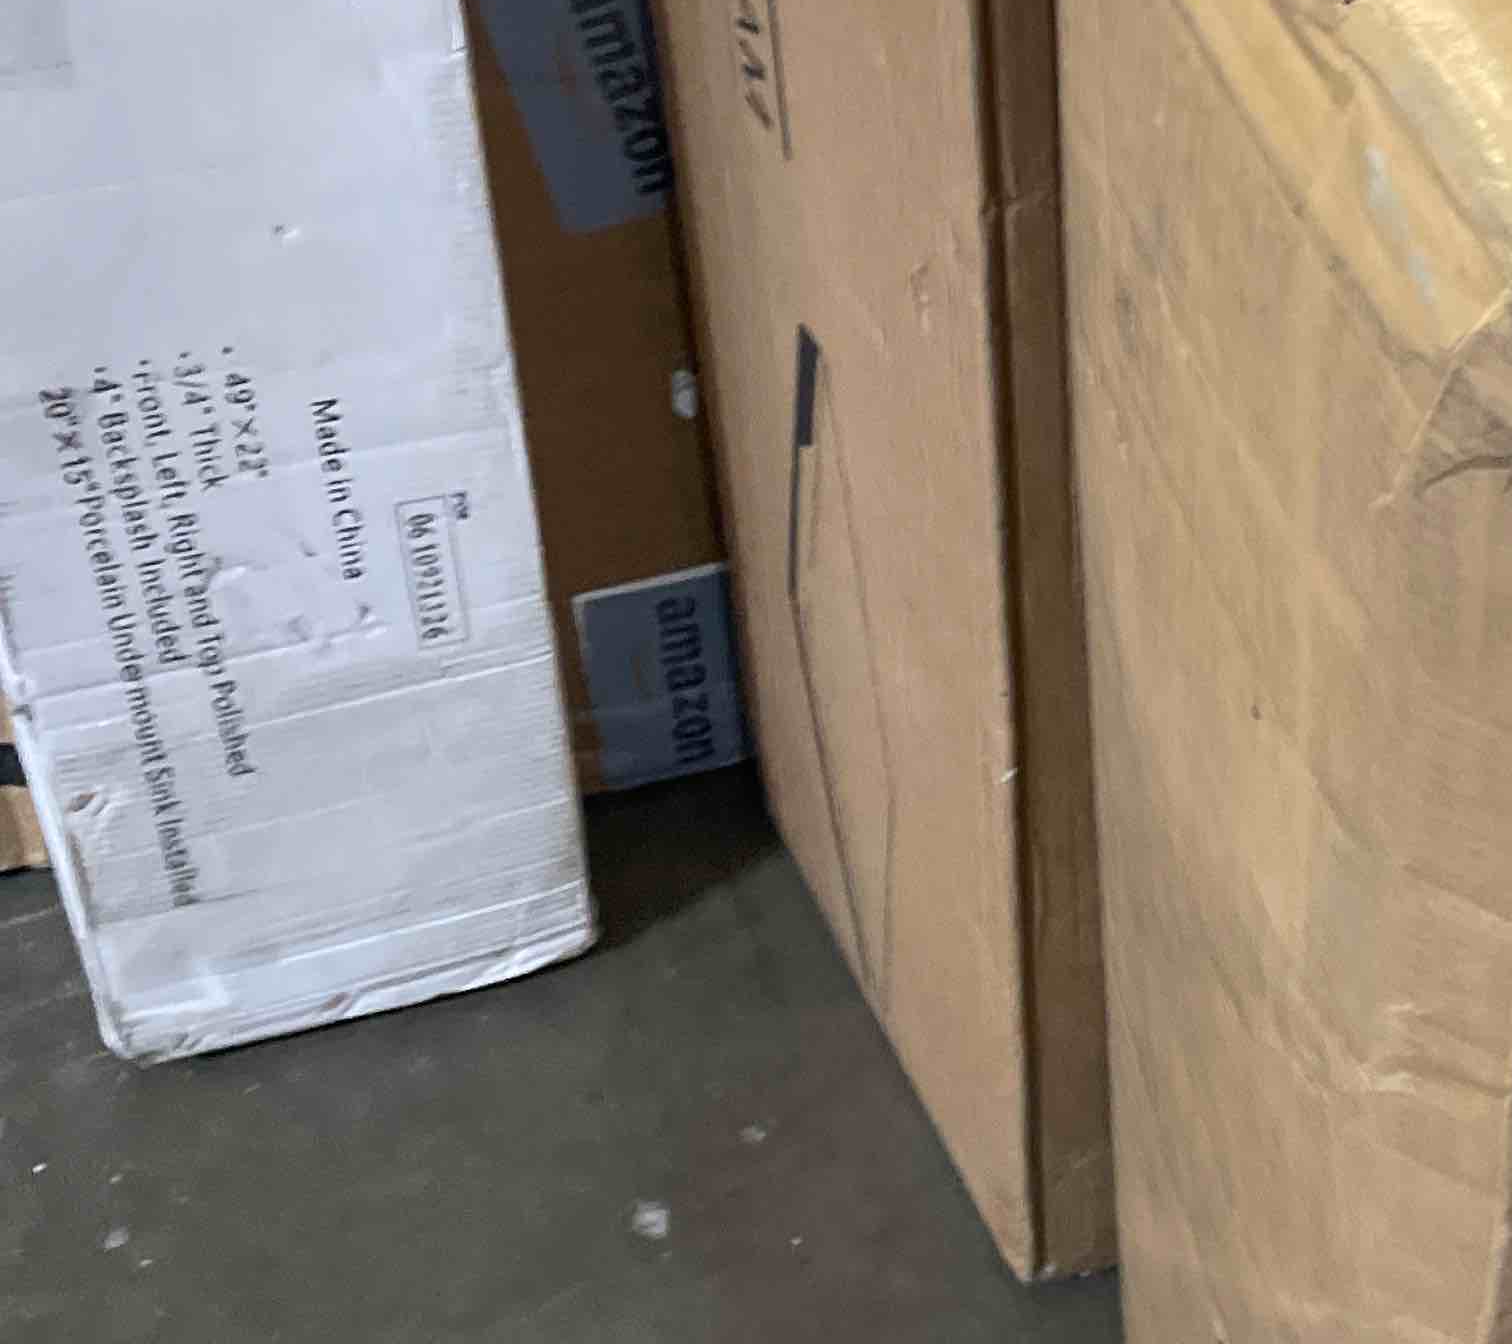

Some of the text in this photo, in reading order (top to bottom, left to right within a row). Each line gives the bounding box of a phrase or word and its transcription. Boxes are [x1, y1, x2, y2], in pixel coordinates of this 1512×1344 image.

[190, 426, 229, 490] Thick
[309, 398, 366, 581] Made in China
[98, 412, 158, 552] Backsplash
[137, 558, 193, 665] Included
[164, 513, 206, 580] Right
[184, 584, 220, 630] and
[198, 632, 226, 677] Top
[654, 595, 716, 767] amazon
[209, 680, 258, 778] Polished
[145, 766, 183, 816] Sink
[155, 818, 201, 907] Installed
